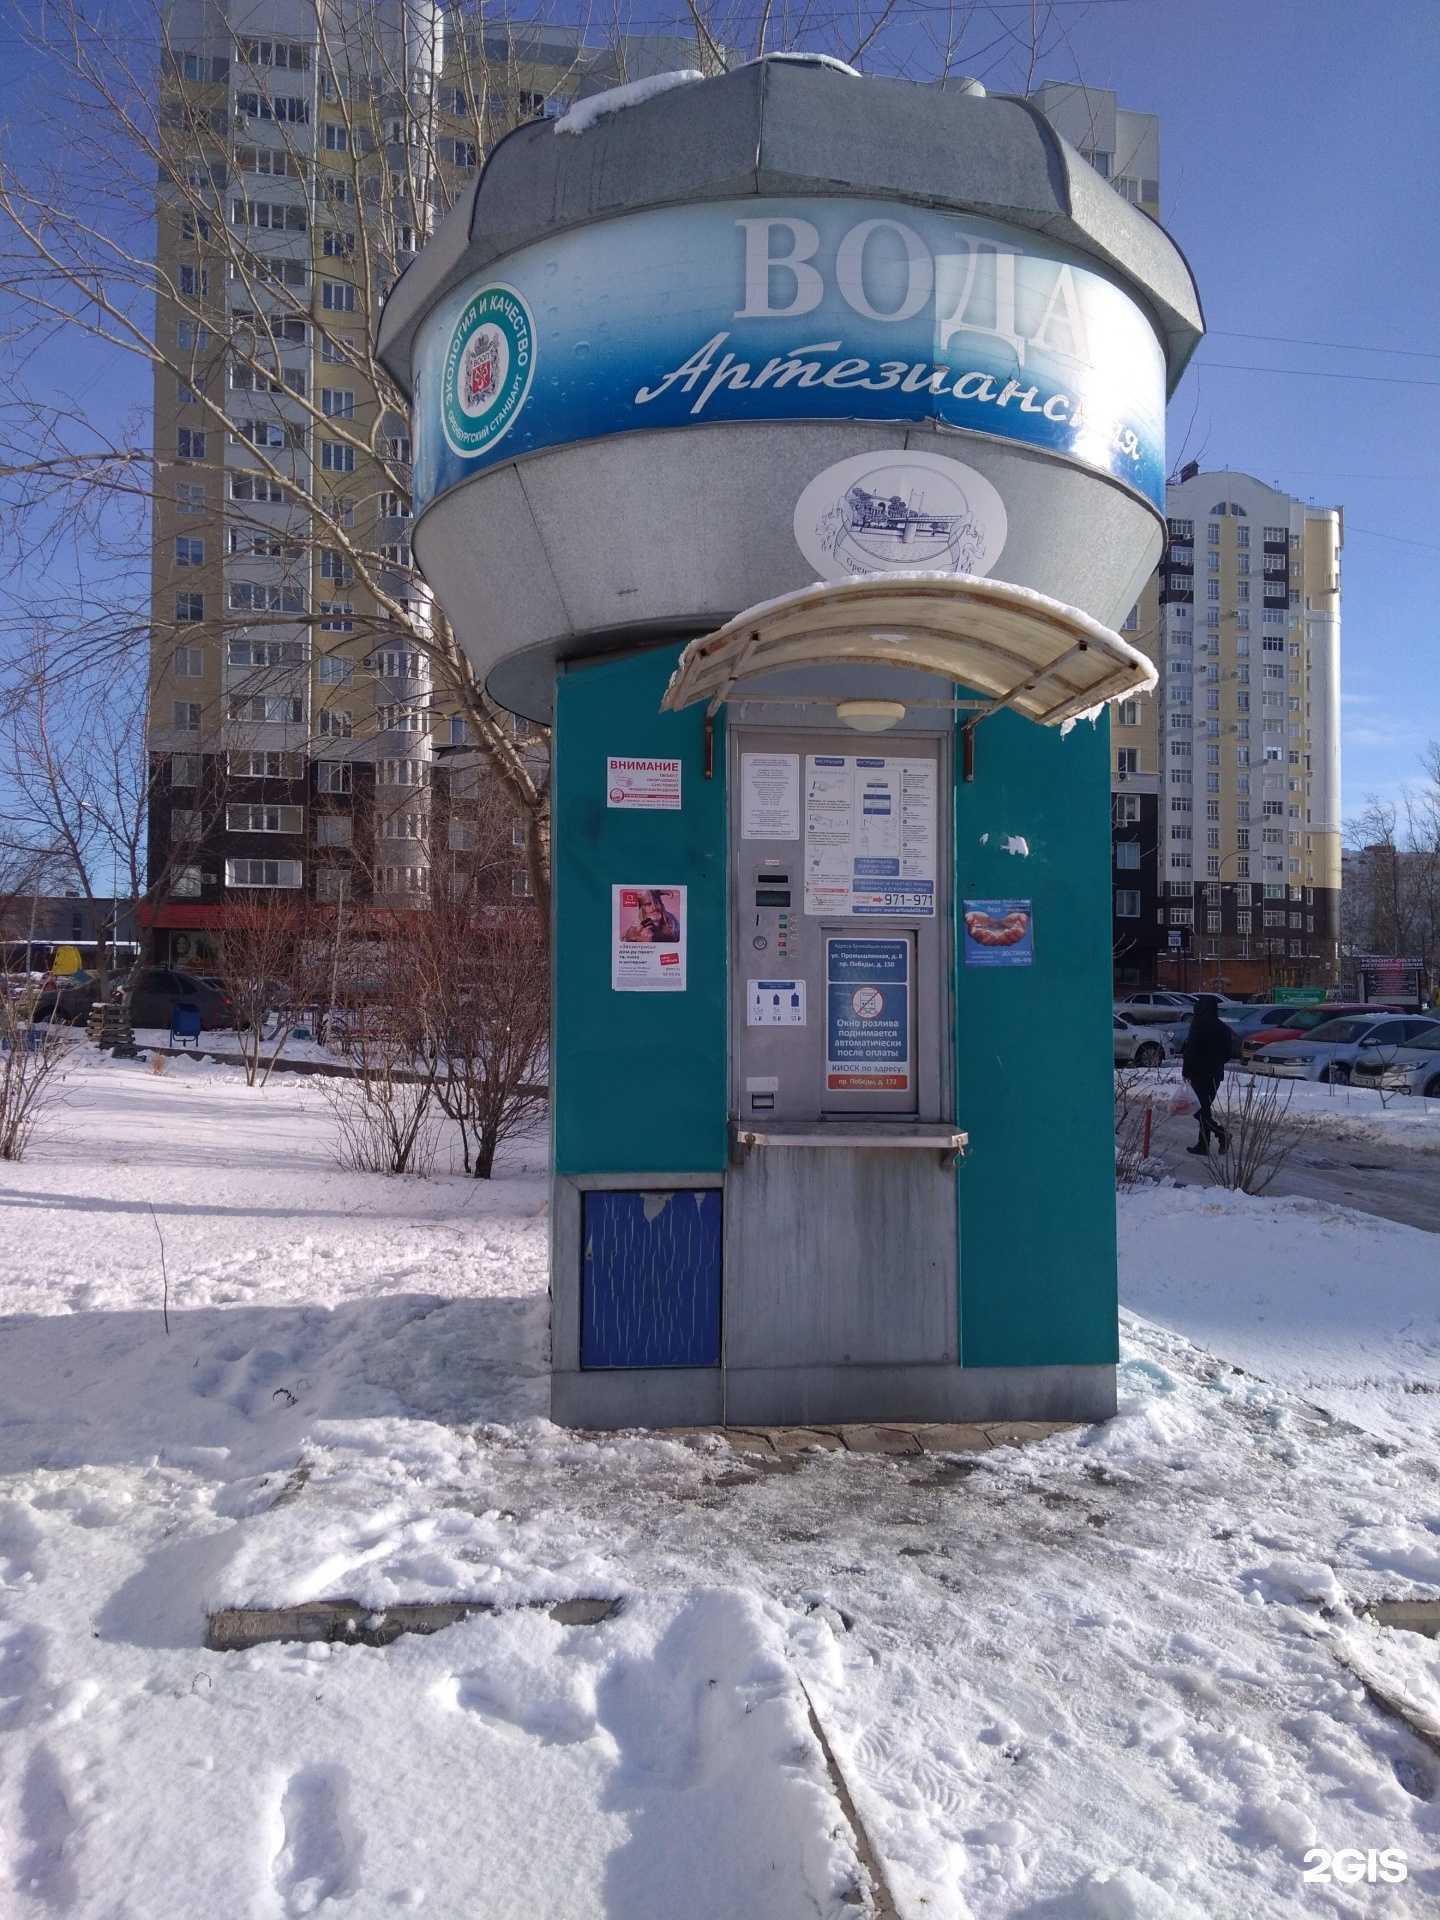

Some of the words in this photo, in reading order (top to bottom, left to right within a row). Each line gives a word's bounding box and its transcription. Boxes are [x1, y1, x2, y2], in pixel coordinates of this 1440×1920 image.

[733, 214, 1091, 367] ВОДА
[445, 306, 478, 407] ЭКОЛОГИЯ
[479, 297, 487, 315] И
[489, 295, 529, 367] КАЧЕСТВО
[634, 332, 1141, 461] Артезианся
[489, 374, 524, 432] СТАНДАРТ
[610, 760, 679, 771] ВНИМАНИЕ
[884, 894, 933, 906] 971-971
[836, 1019, 860, 1027] Окно
[862, 1019, 899, 1029] розлива
[838, 1030, 898, 1038] поднимается
[837, 1049, 863, 1057] после
[831, 1064, 860, 1072] КИОСК
